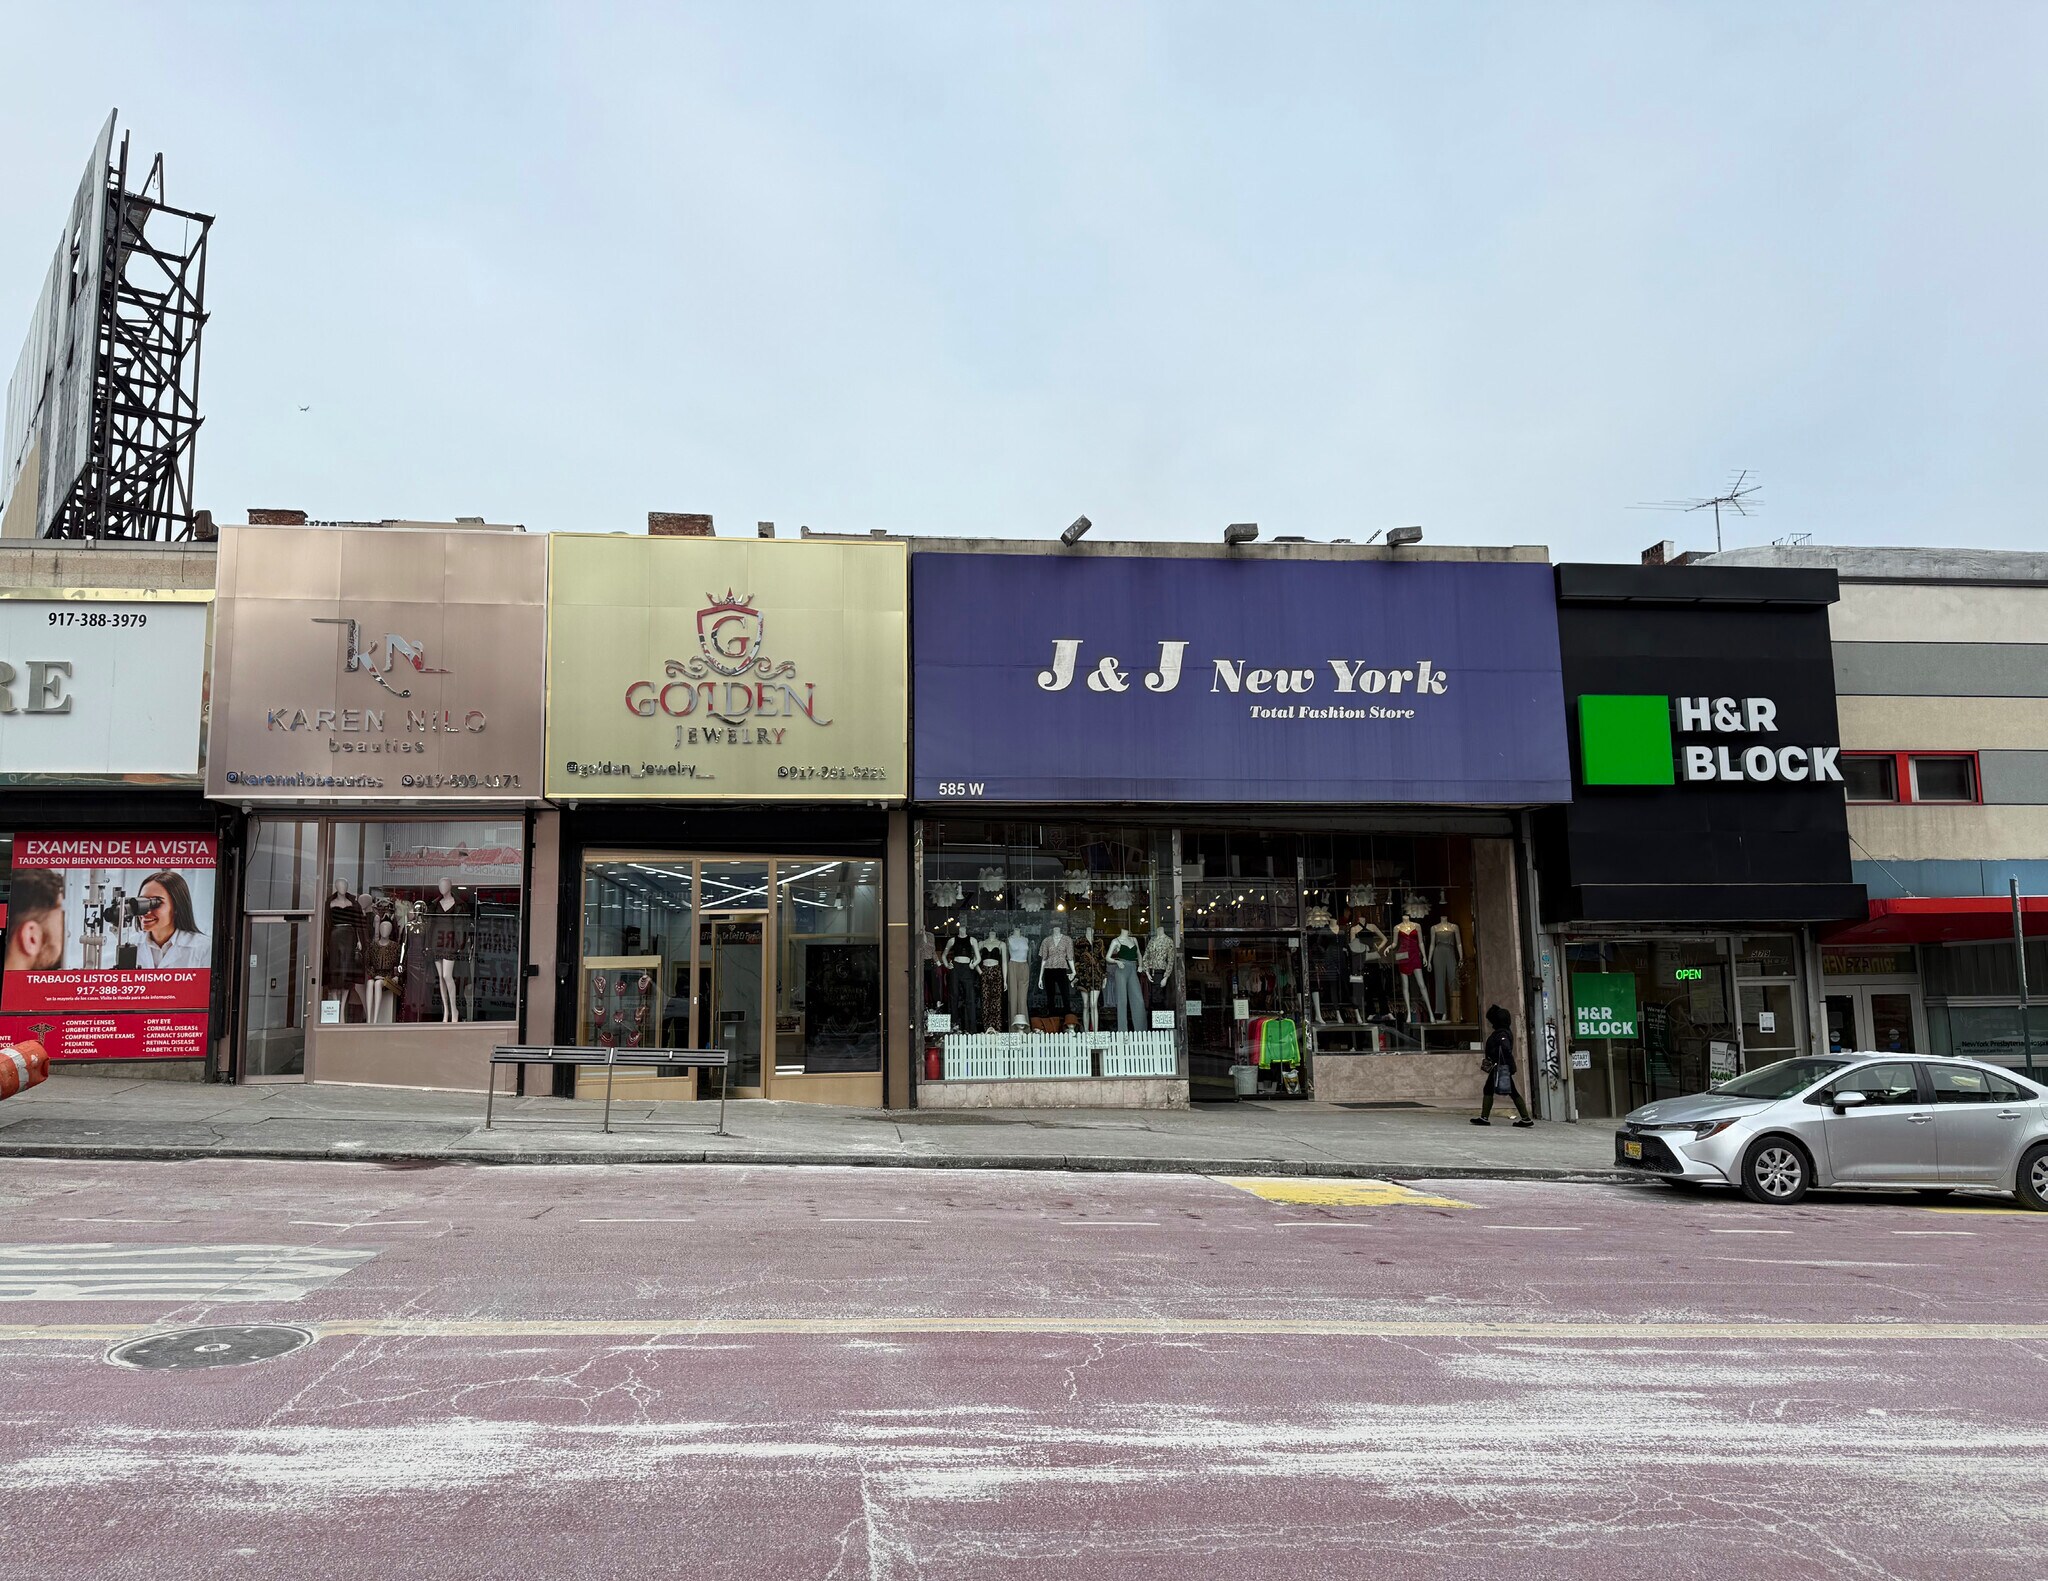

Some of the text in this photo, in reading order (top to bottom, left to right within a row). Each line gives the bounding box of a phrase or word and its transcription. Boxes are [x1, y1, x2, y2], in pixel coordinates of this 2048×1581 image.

[48, 612, 147, 627] 917-388-3979
[711, 615, 750, 658] G
[1037, 640, 1448, 695] J & J New York
[625, 680, 834, 727] GOLDEN
[1250, 705, 1415, 719] Total Fashion Store
[1677, 696, 1779, 732] H&R
[267, 708, 488, 733] KAREN NILO
[674, 724, 786, 750] JEWELRY
[328, 737, 425, 753] beauties
[1682, 746, 1844, 782] BLOCK
[939, 783, 985, 796] 585 W
[27, 840, 209, 854] EXAMEN DE LA VISTA
[18, 857, 49, 865] TADOS
[50, 857, 70, 865] SON
[72, 857, 135, 865] BIENVENIDOS.
[136, 857, 151, 865] NO
[152, 857, 194, 865] NECESITA
[27, 975, 81, 984] TRABAJOS
[83, 974, 119, 983] LISTOS
[121, 974, 132, 982] EL
[134, 973, 173, 982] MISMO
[1675, 969, 1702, 980] OPEN
[76, 985, 147, 995] 917-388-3979
[1155, 1014, 1172, 1025] SALE
[1577, 1007, 1613, 1020] H&R
[931, 1017, 949, 1028] SALE
[1579, 1022, 1634, 1035] BLOCK
